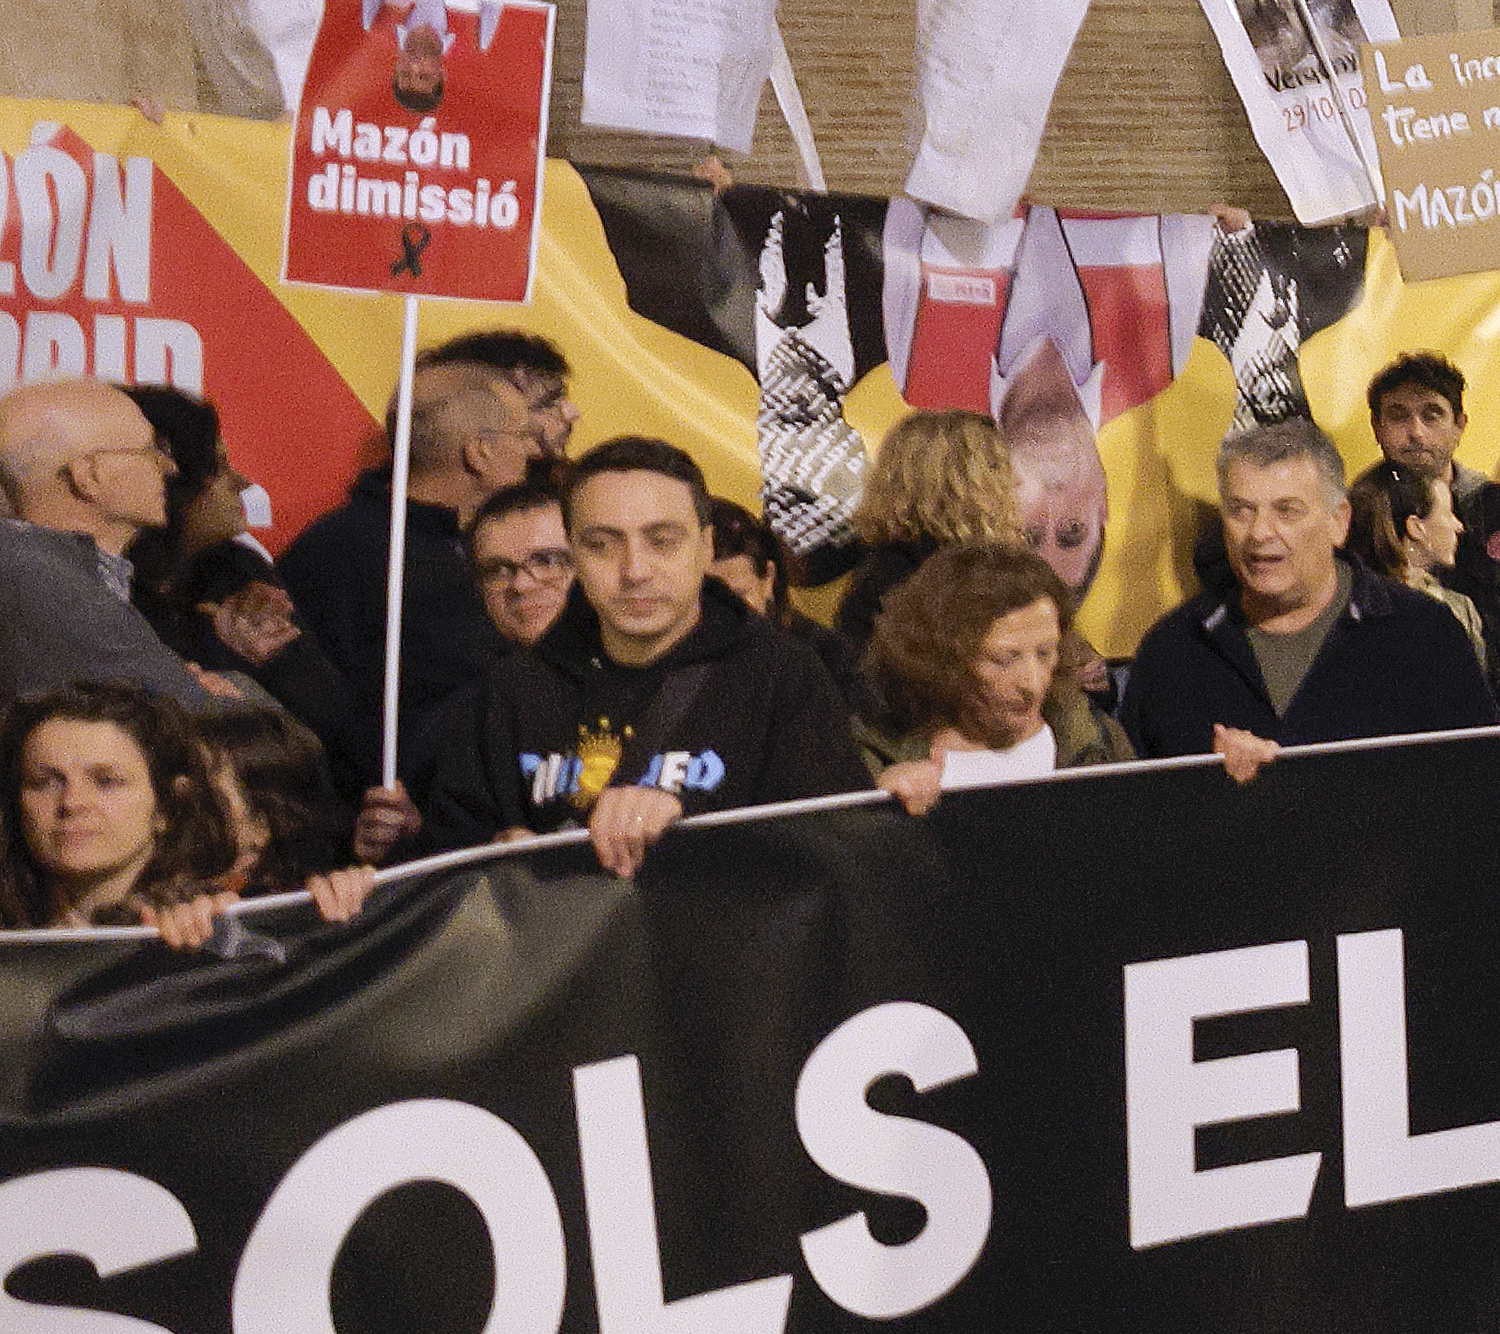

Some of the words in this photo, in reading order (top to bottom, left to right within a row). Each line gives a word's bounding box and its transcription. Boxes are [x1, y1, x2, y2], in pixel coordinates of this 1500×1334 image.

[1374, 49, 1433, 93] La
[312, 107, 470, 171] Mazón
[1382, 104, 1470, 146] tiene
[0, 121, 154, 305] ÓN
[308, 164, 520, 228] dimissió
